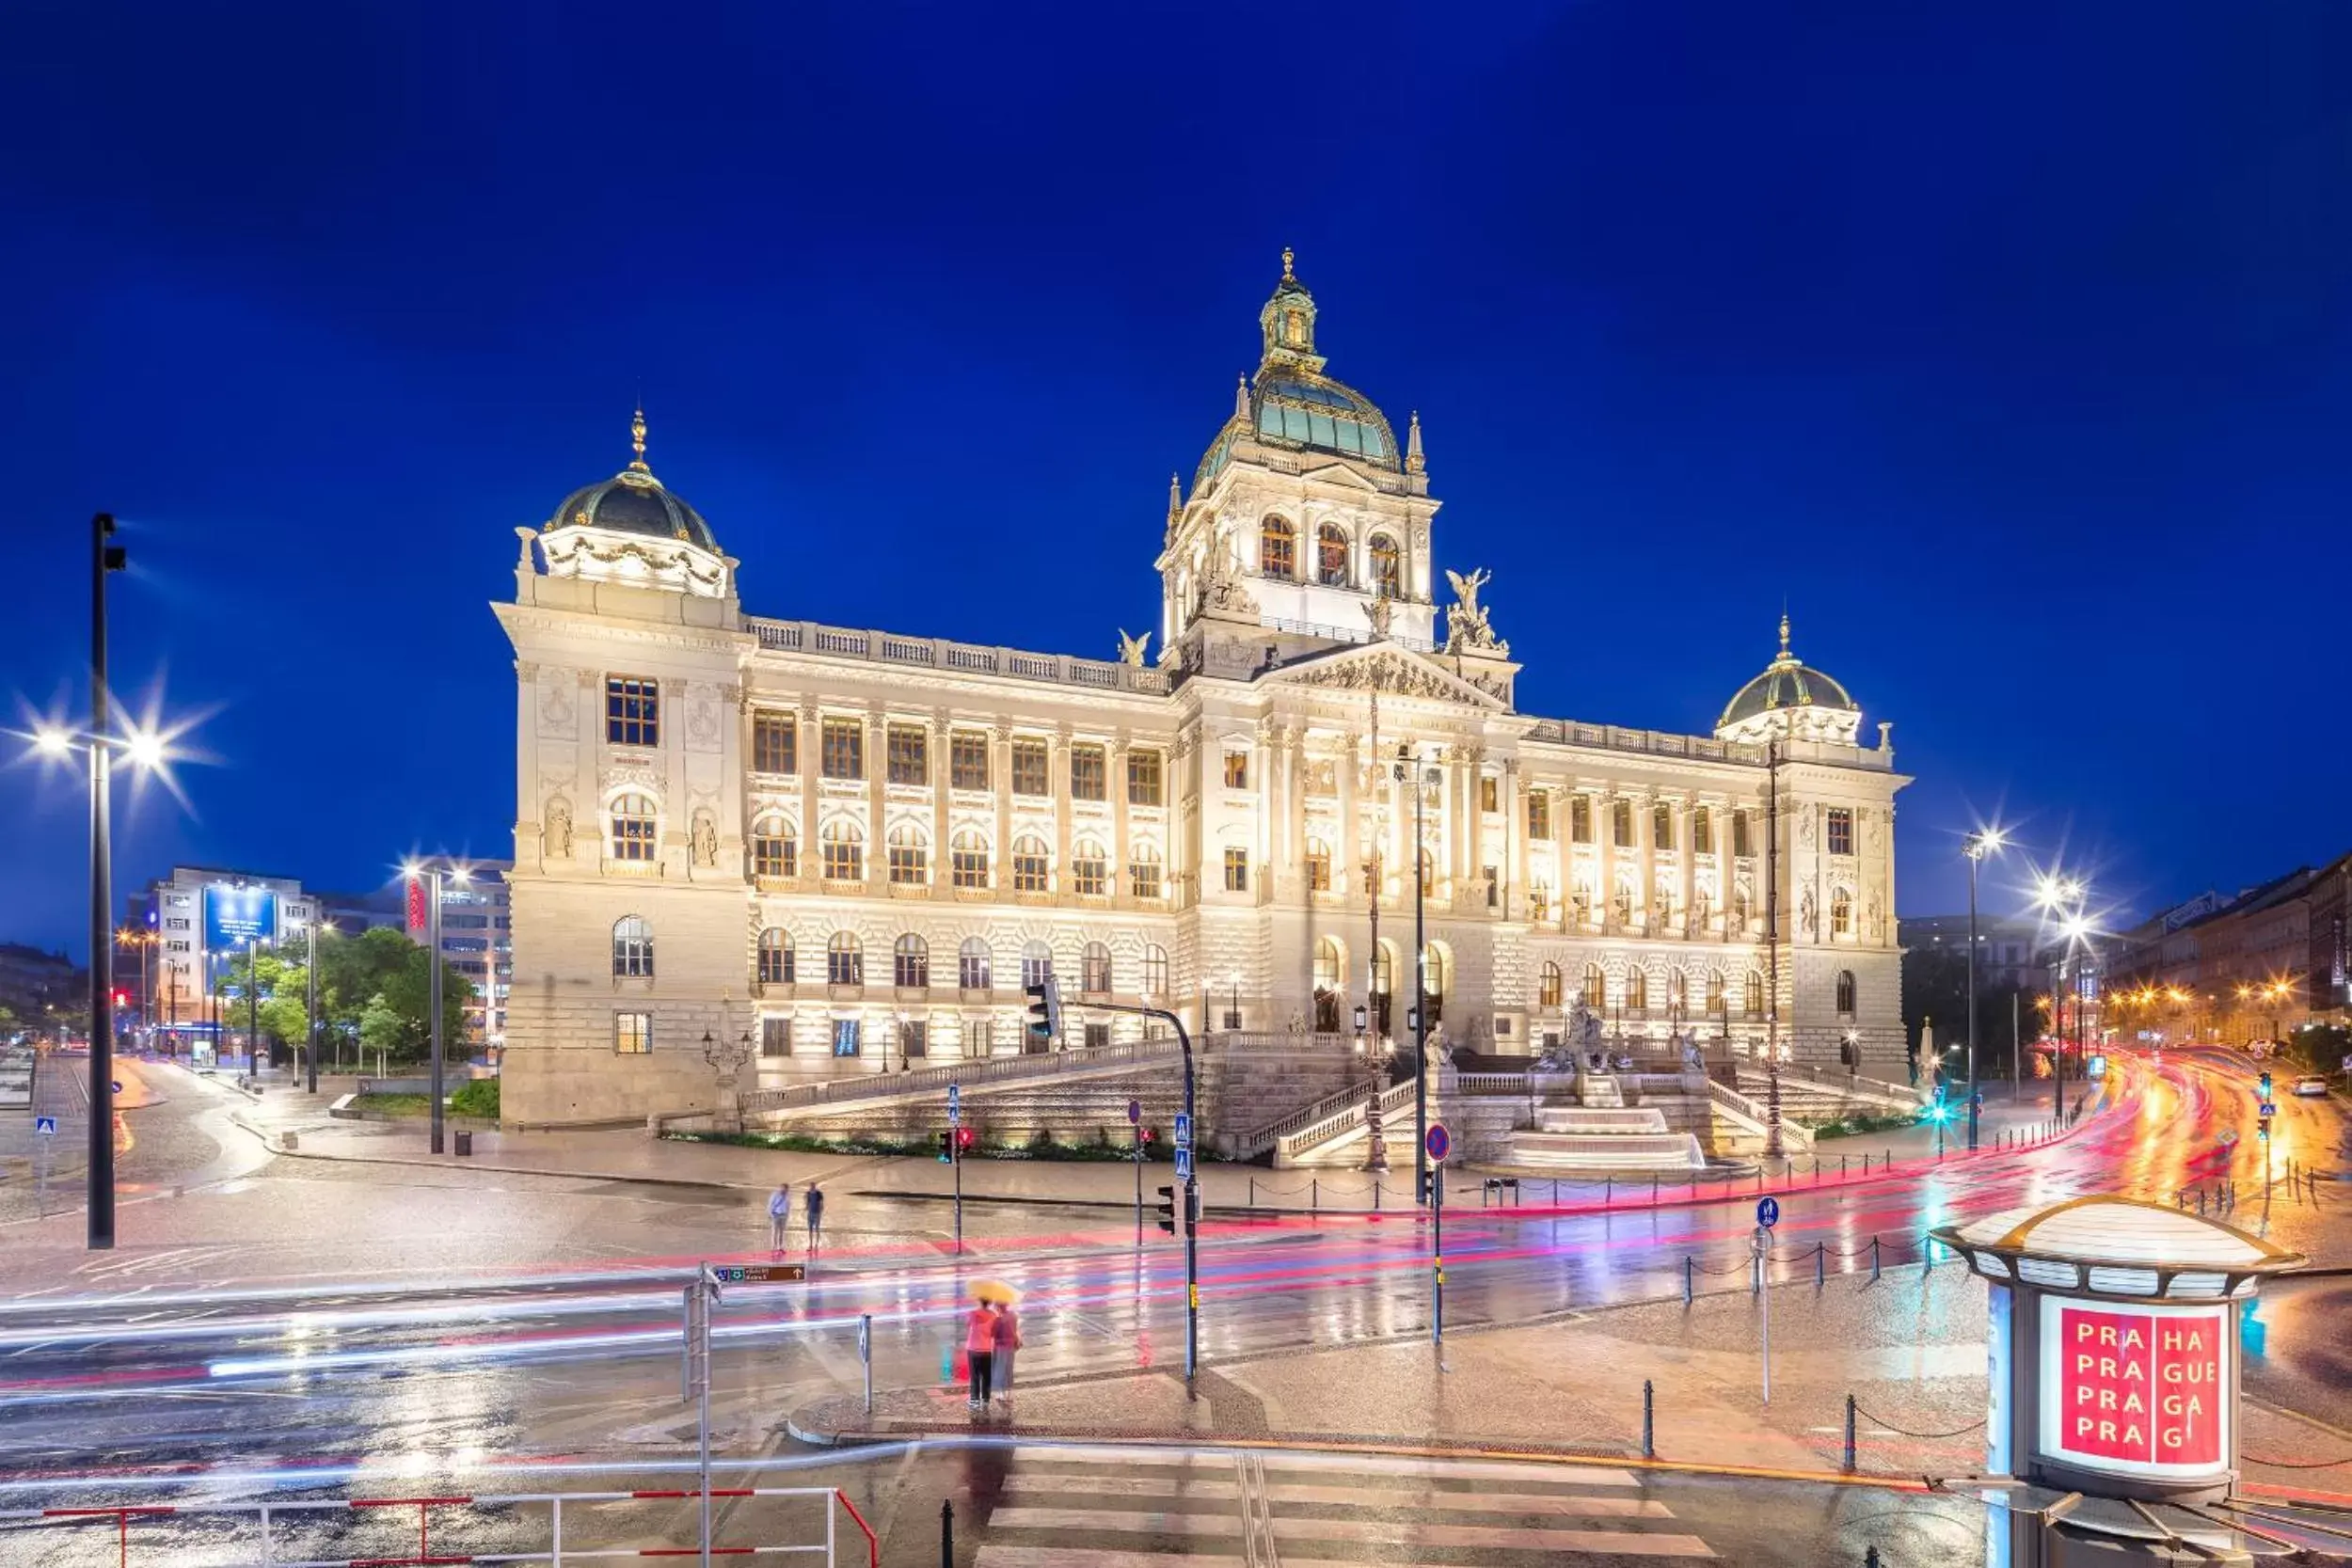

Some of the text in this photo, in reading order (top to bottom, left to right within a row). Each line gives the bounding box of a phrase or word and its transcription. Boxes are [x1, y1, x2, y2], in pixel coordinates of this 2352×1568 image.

[2077, 1323, 2203, 1352] PRA HA
[2077, 1354, 2216, 1385] PRA GUE
[2077, 1385, 2203, 1416] PRA GA
[2076, 1417, 2183, 1449] PRA G
